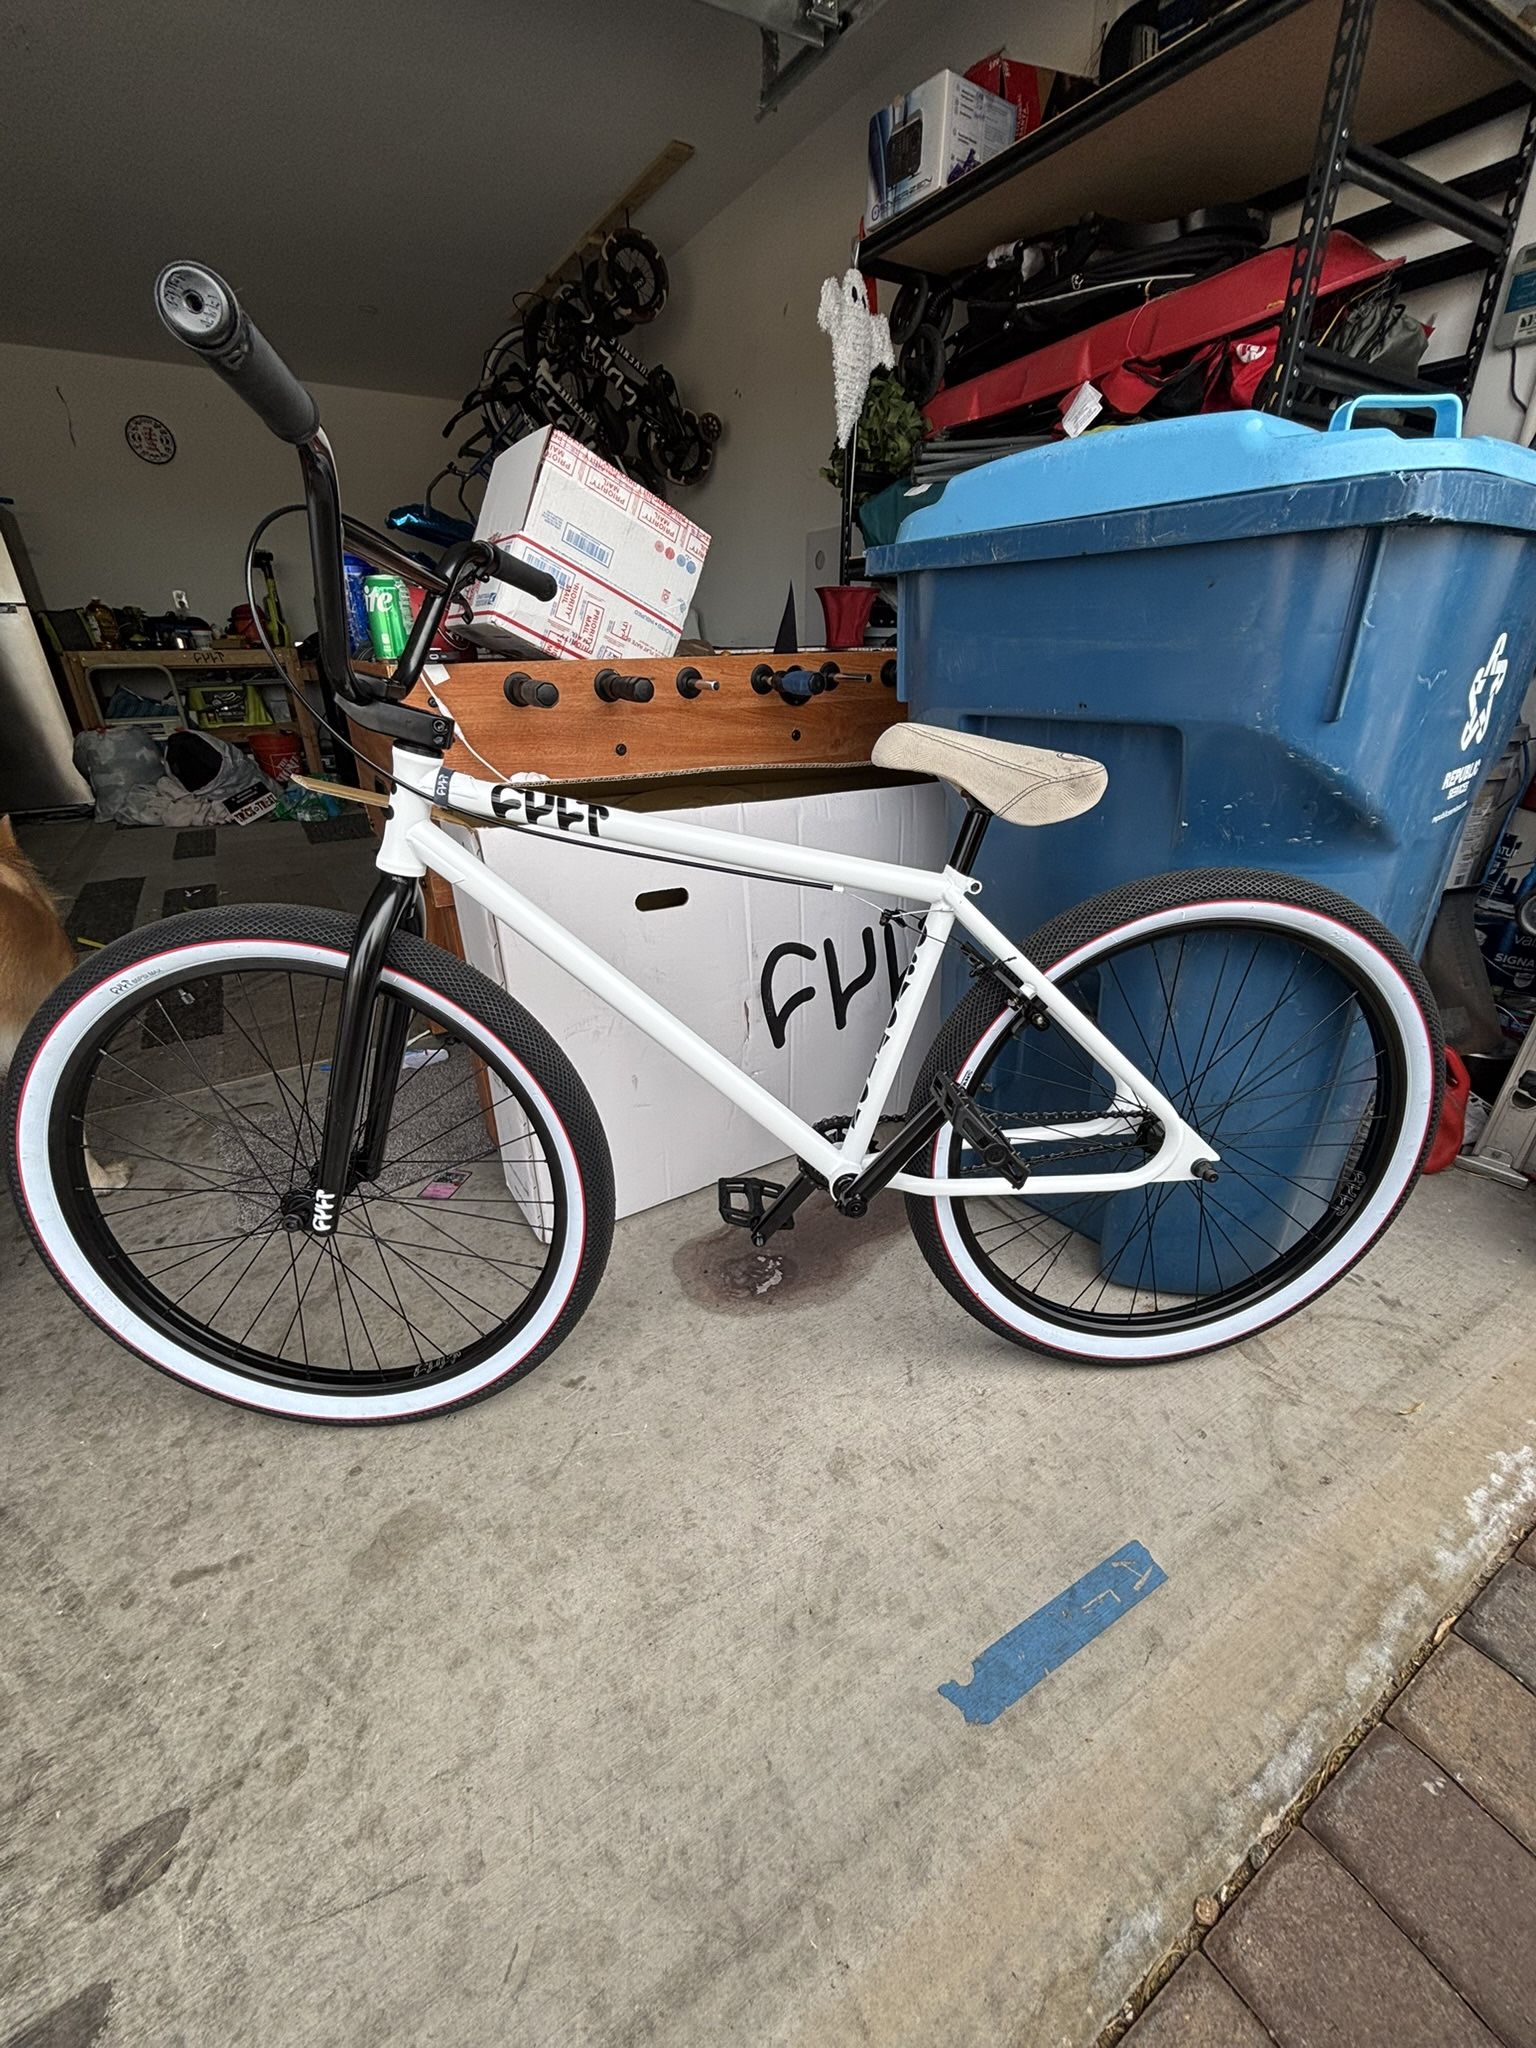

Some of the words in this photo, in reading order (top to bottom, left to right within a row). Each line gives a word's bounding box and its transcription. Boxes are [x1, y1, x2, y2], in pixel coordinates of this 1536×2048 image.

[590, 478, 626, 506] PRIORITY
[602, 476, 621, 494] MAIL
[643, 512, 676, 538] PRIORITY
[654, 511, 670, 527] MAIL
[193, 651, 225, 664] CULT
[436, 774, 450, 796] CULT
[1441, 758, 1482, 790] REPUBLIC
[490, 784, 610, 838] CULT
[1494, 952, 1536, 968] SIGNA
[109, 979, 133, 995] CULT
[311, 1189, 335, 1232] CULT
